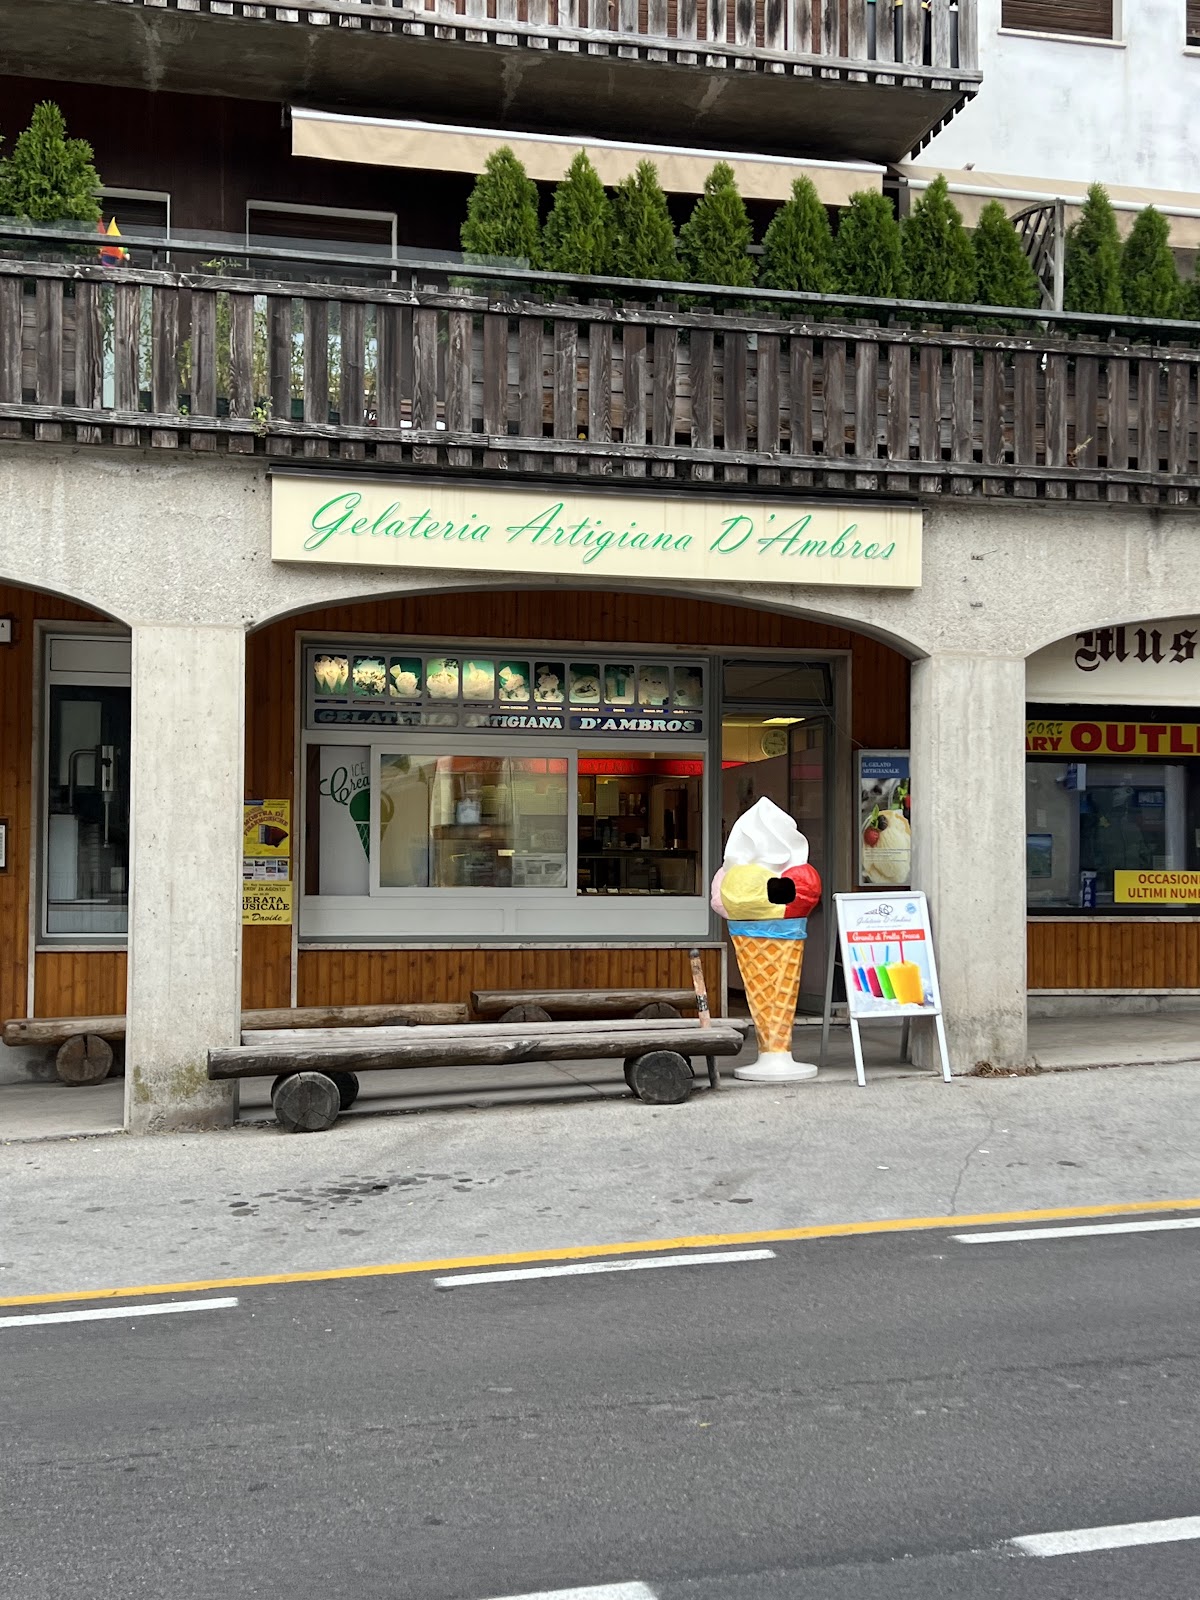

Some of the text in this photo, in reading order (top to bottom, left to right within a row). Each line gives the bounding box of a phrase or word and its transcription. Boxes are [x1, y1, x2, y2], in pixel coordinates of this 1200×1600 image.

[303, 492, 896, 564] Gelateria Artigiana D'Ambros
[579, 717, 695, 732] D'AMBROS
[1070, 722, 1200, 753] OUTL
[351, 762, 367, 777] ICE
[1138, 874, 1200, 885] OCCASION
[1128, 888, 1167, 898] ULTIMI
[251, 912, 283, 922] Davide
